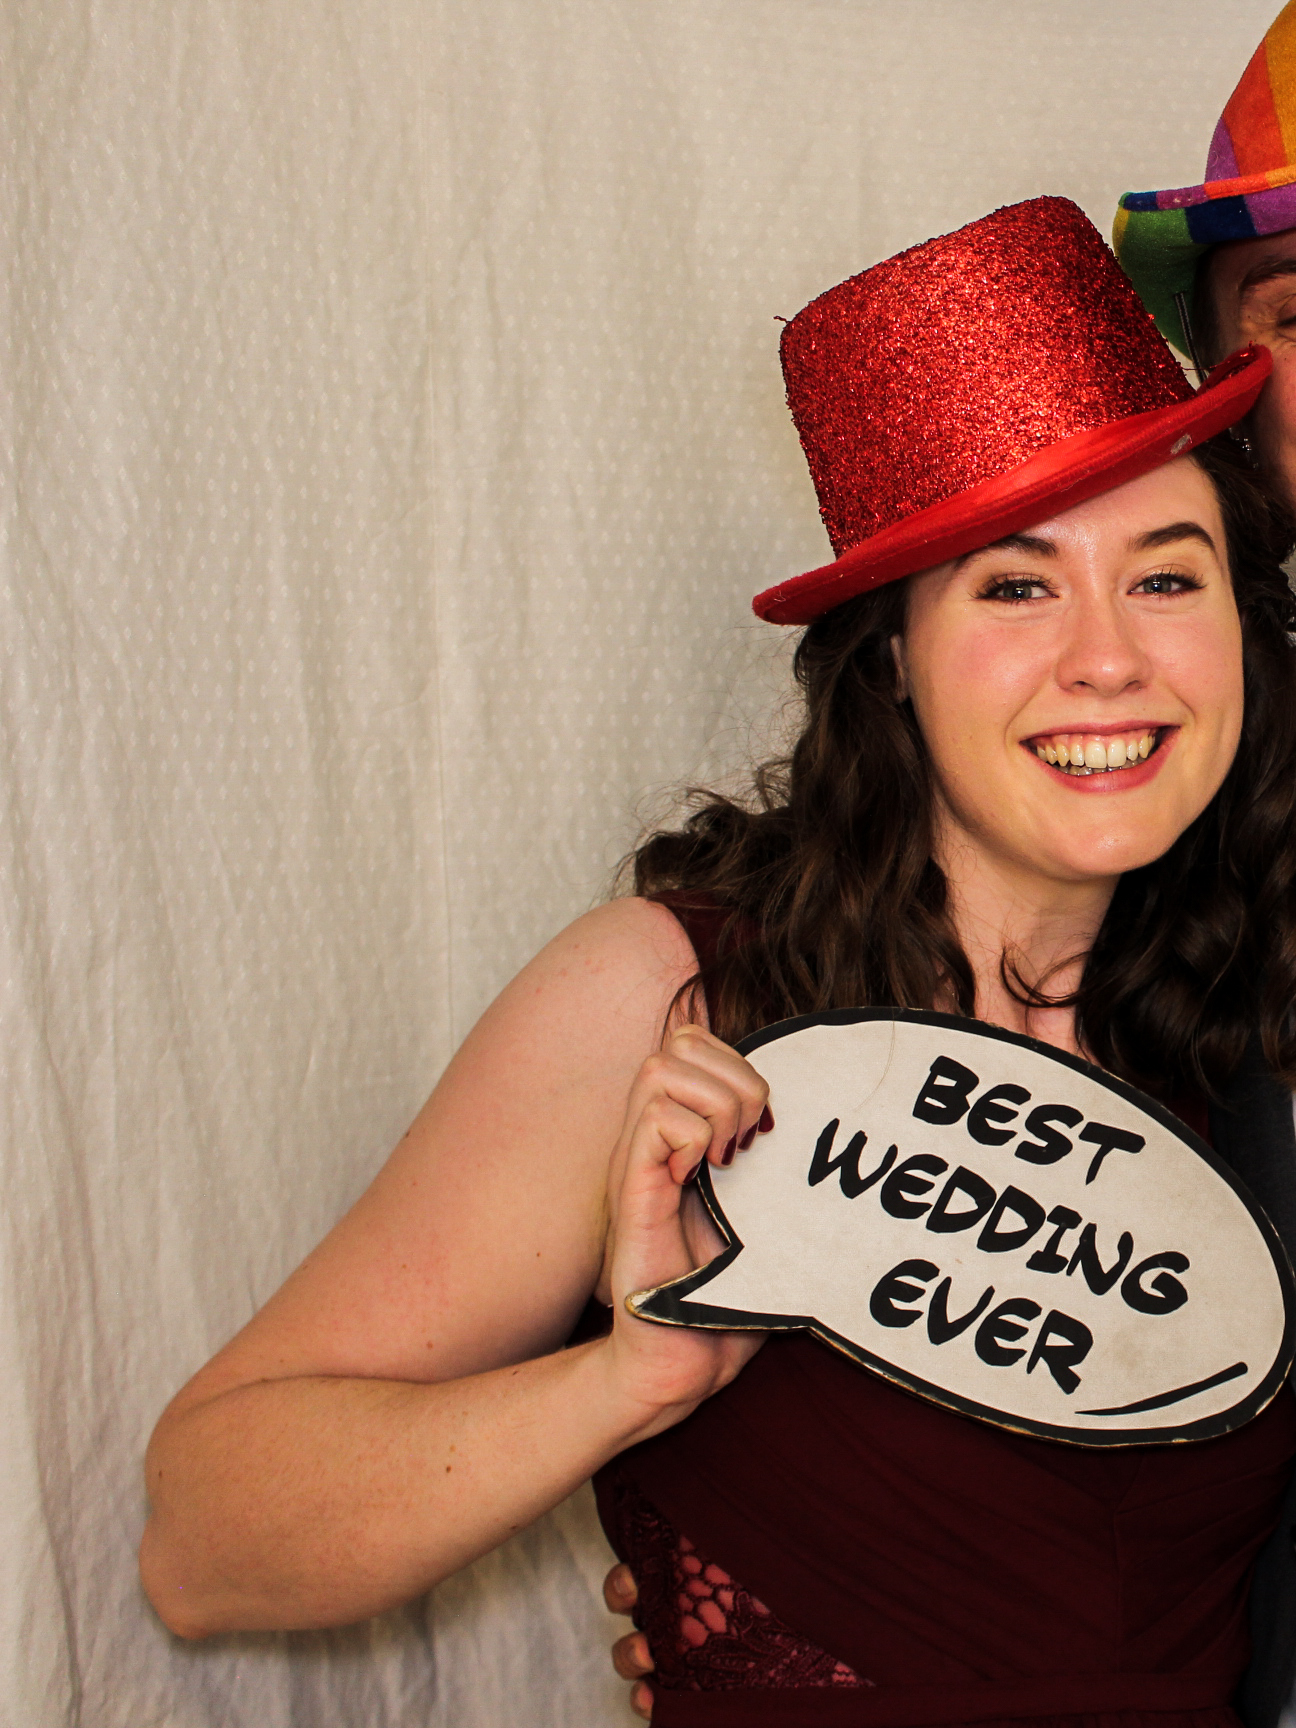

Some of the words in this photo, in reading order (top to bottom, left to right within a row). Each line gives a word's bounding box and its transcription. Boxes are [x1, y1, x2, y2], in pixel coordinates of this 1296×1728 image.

[912, 1055, 1146, 1186] BEST
[808, 1118, 1190, 1315] WEDDING
[869, 1258, 1093, 1395] EVER
